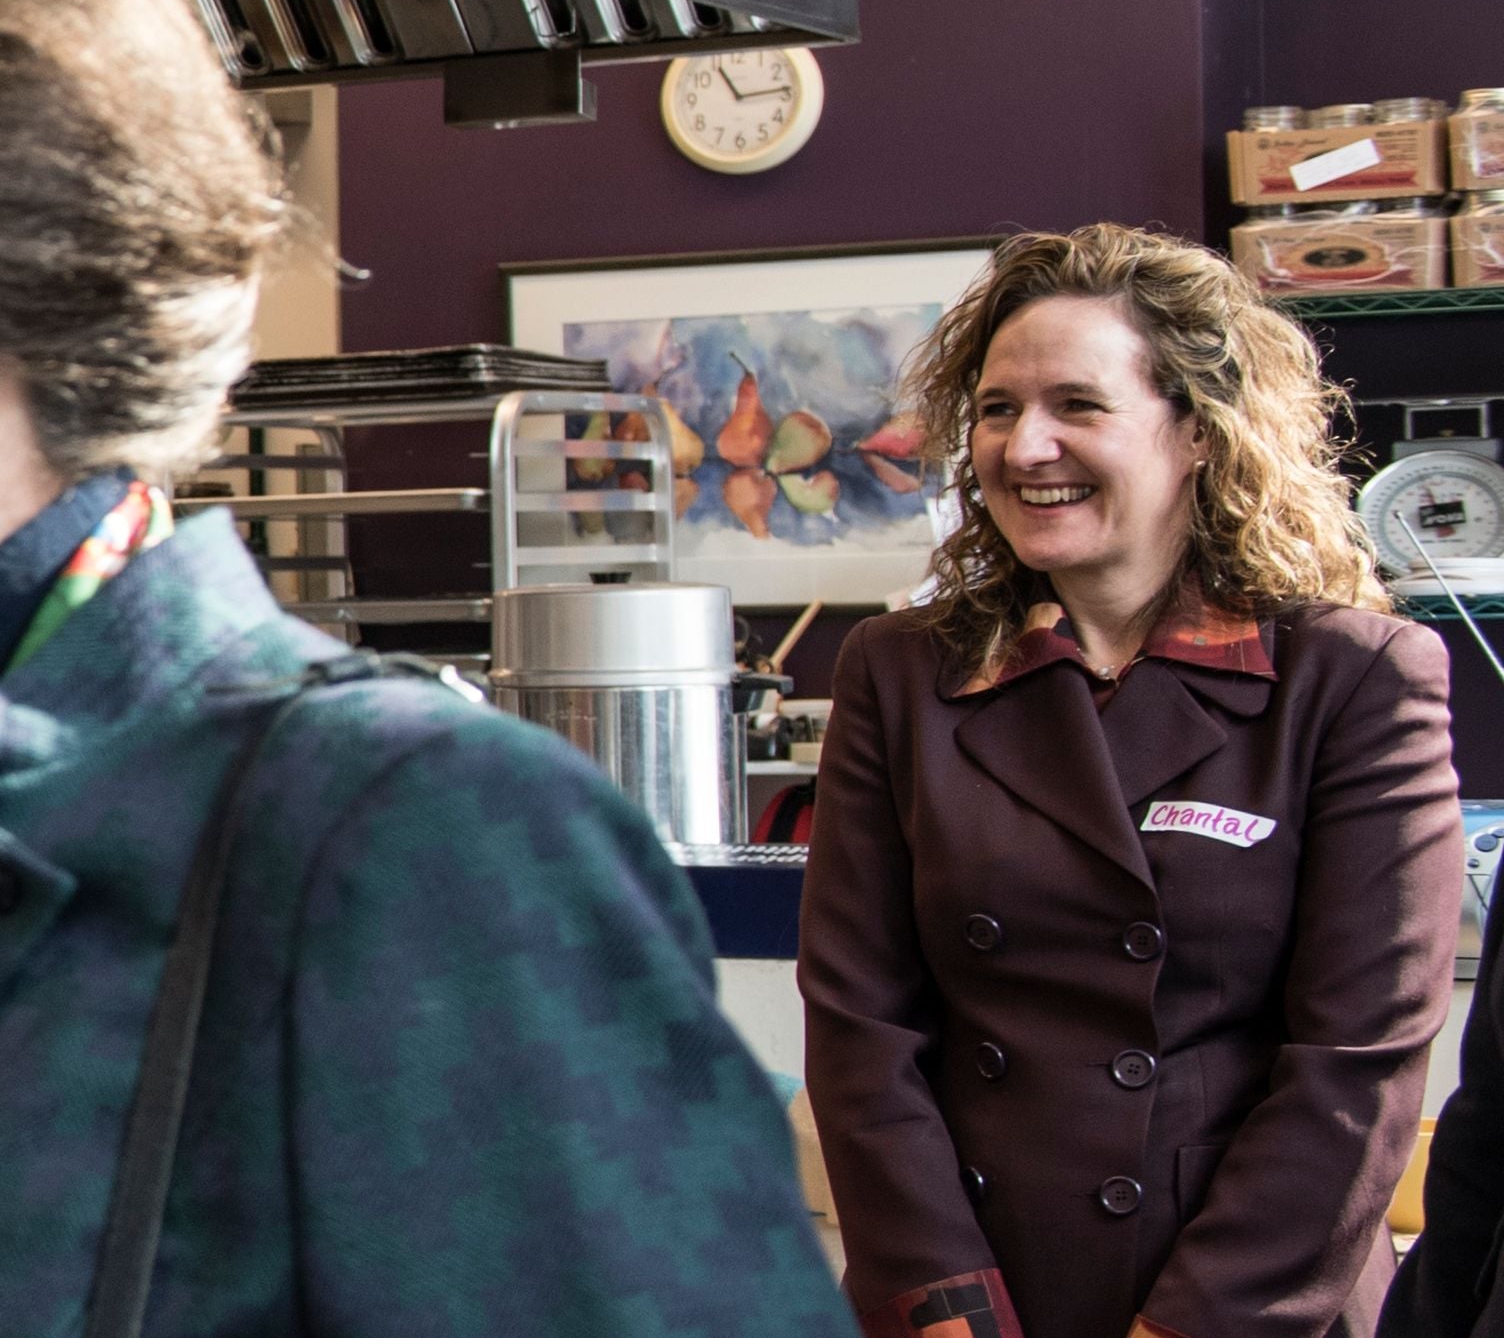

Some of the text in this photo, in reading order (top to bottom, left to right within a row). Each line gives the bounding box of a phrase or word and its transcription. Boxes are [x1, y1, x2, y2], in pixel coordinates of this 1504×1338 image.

[694, 71, 712, 89] 10
[771, 62, 783, 81] 2
[687, 92, 698, 109] 9
[695, 113, 706, 132] 8
[772, 108, 784, 125] 4
[714, 126, 726, 144] 7
[735, 131, 746, 149] 6
[757, 123, 769, 142] 5
[1151, 804, 1259, 842] Chantal
